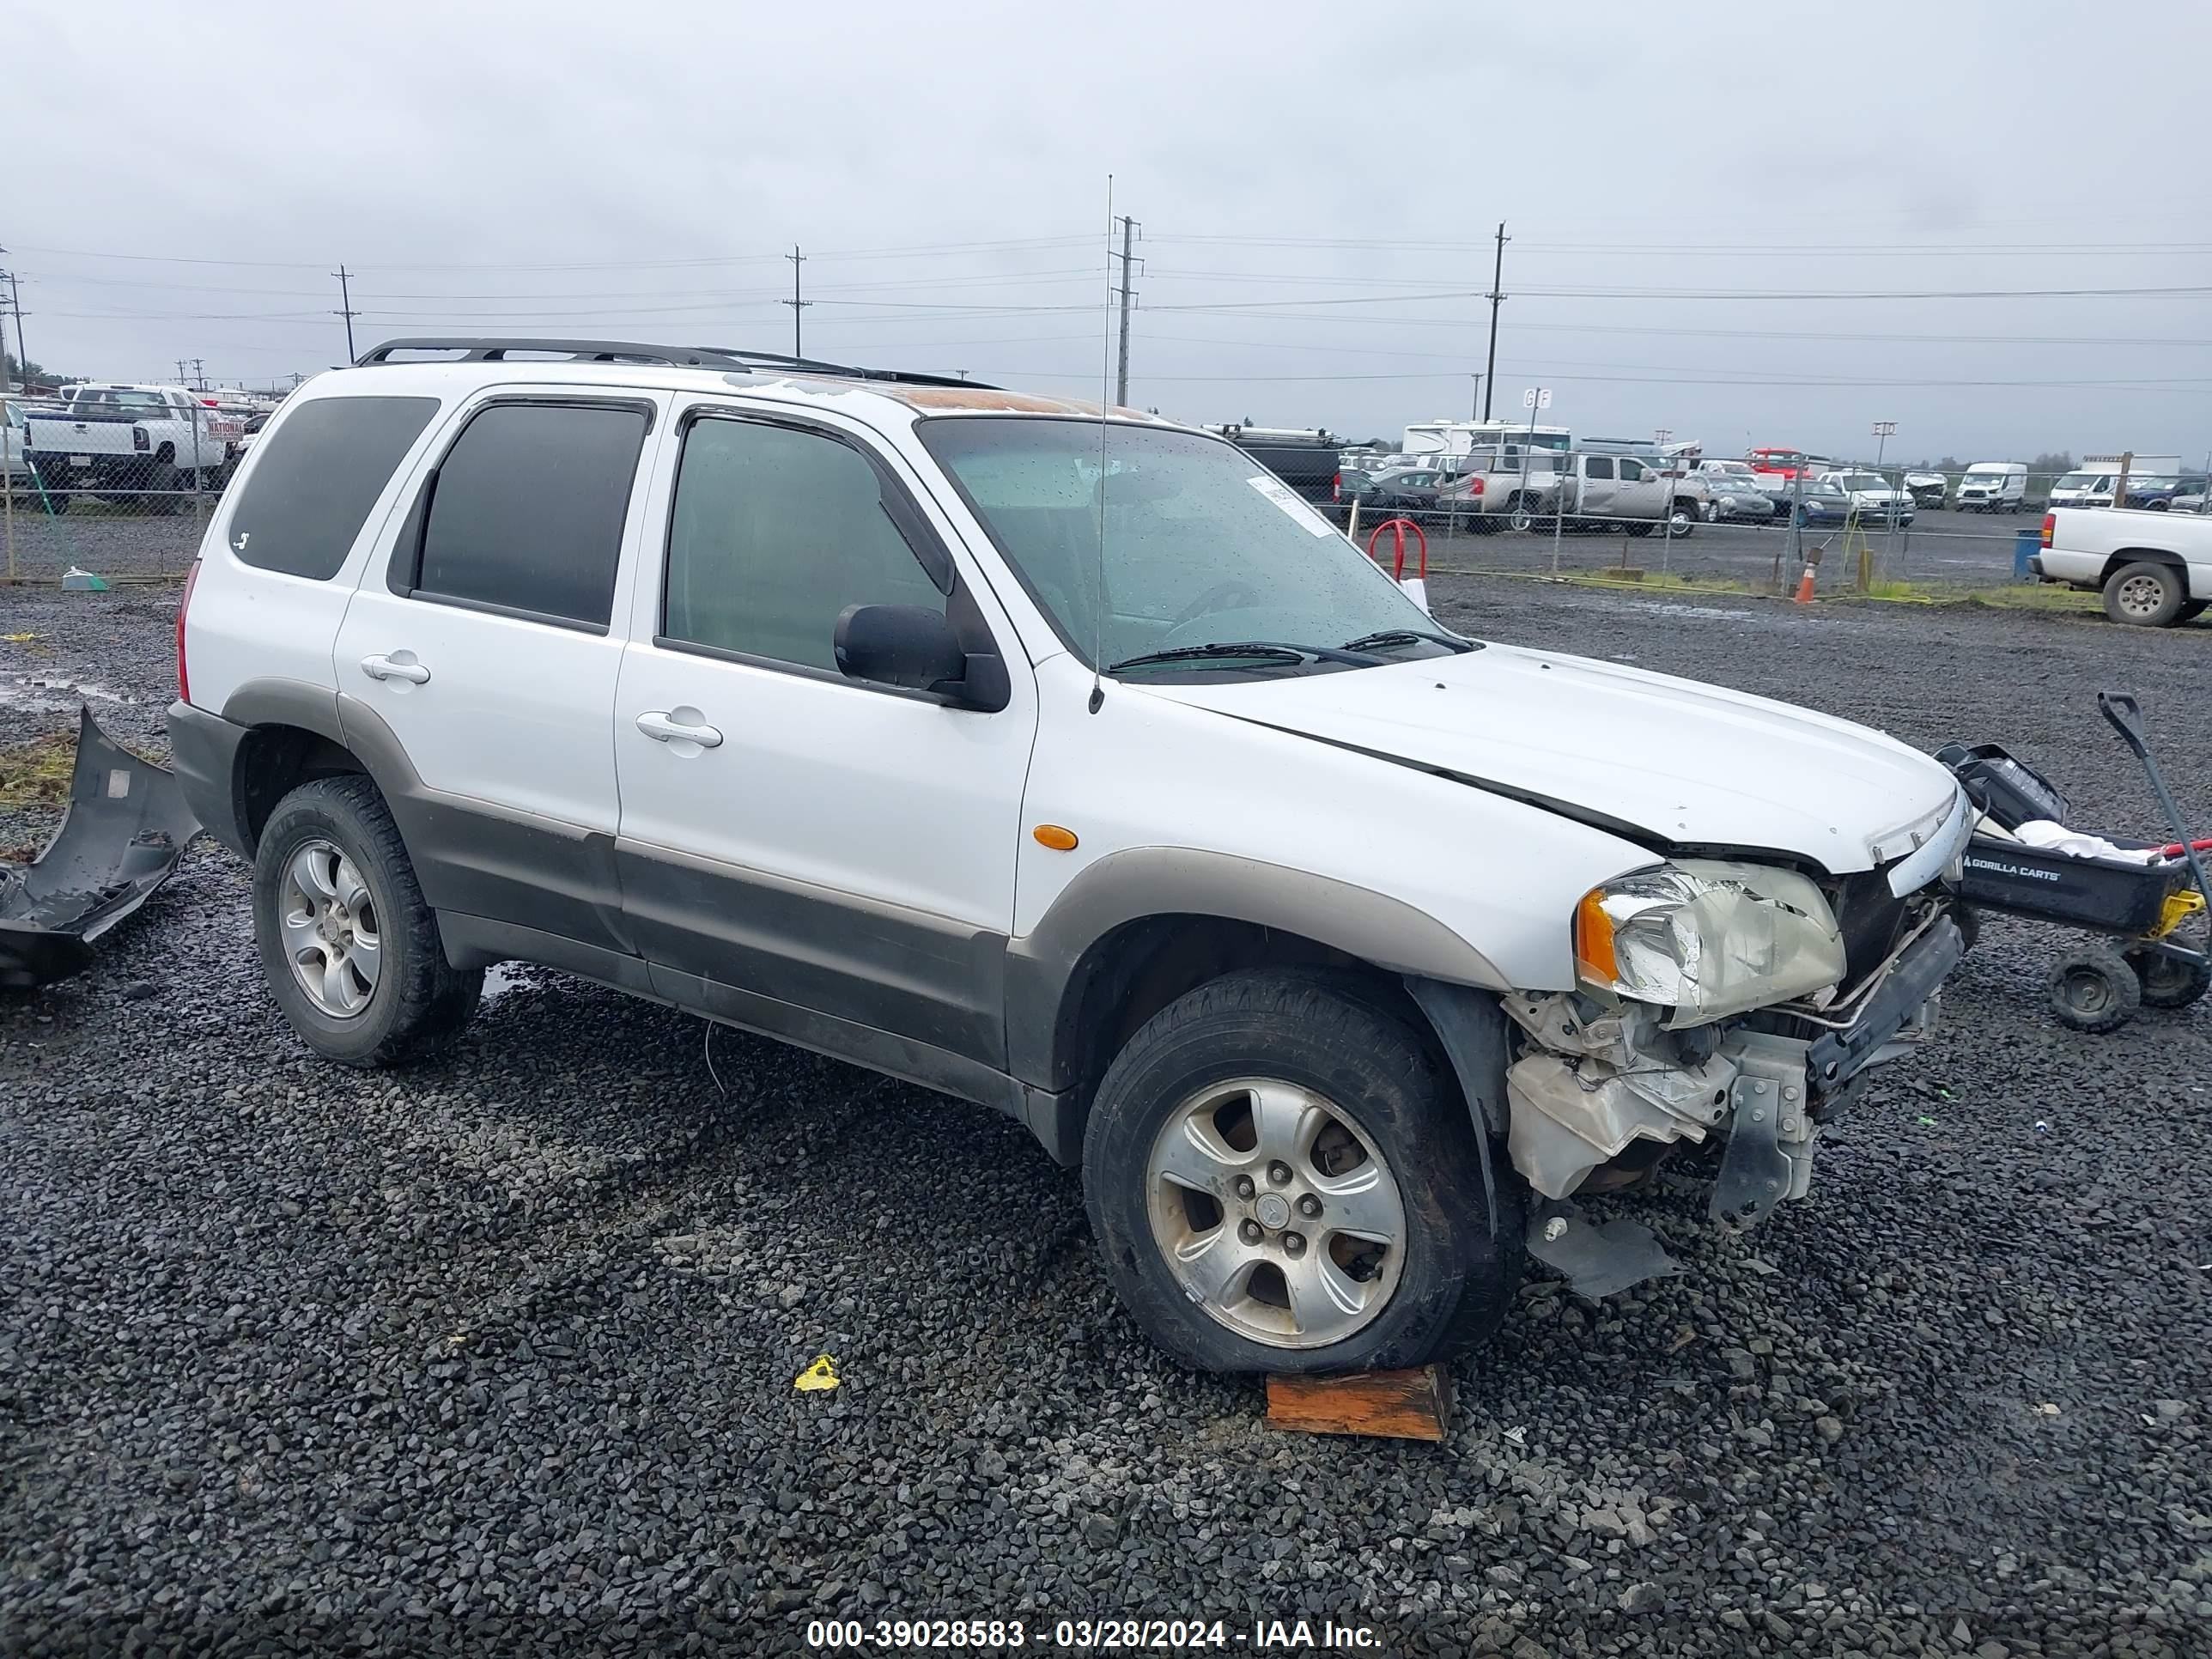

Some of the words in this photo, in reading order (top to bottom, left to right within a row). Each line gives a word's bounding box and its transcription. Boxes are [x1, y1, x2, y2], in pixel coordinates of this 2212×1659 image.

[1526, 391, 1534, 406] G
[1540, 391, 1550, 406] F
[209, 422, 243, 432] NATIONAL
[1972, 859, 2018, 874] GORILLA
[2019, 866, 2060, 881] CARTS
